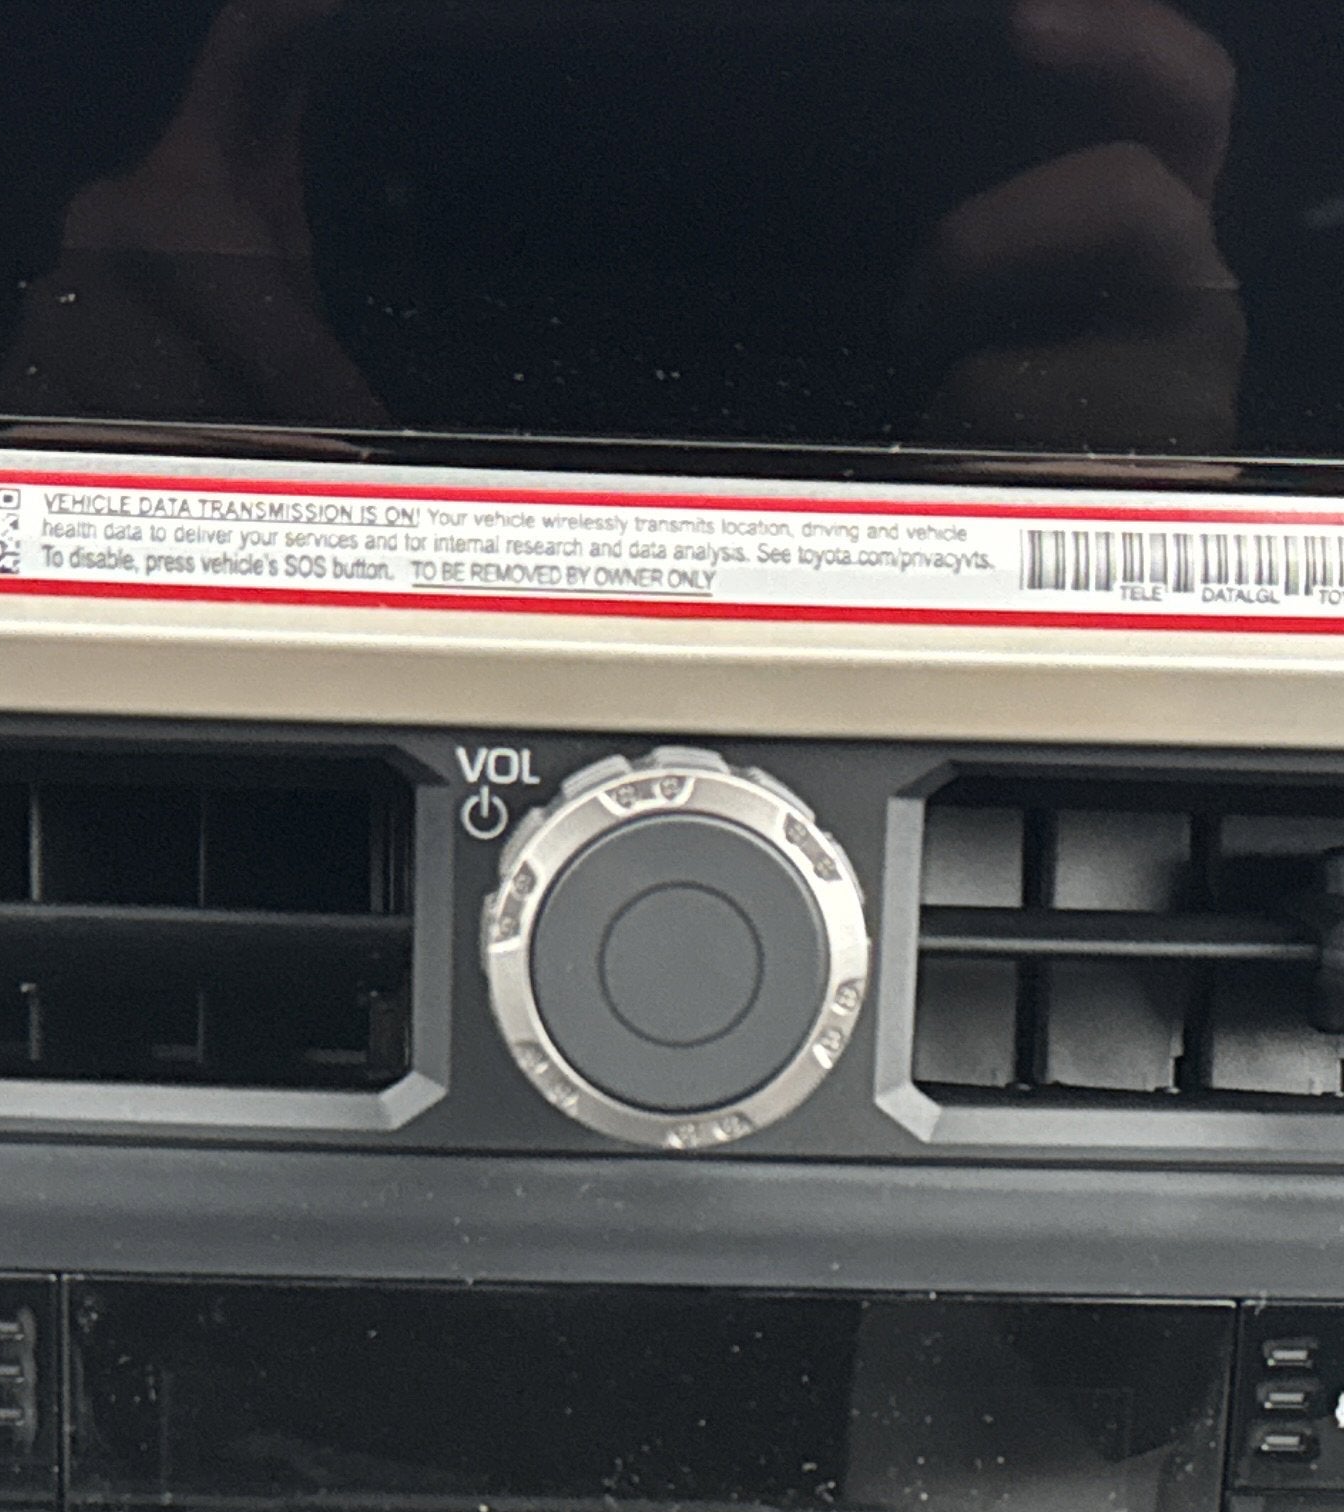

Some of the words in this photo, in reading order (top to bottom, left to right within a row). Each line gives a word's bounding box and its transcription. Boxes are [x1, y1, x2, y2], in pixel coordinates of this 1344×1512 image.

[44, 492, 132, 515] VEHICLE
[139, 496, 191, 517] DATA
[198, 499, 353, 523] TRANSMISSION
[361, 505, 377, 523] IS
[385, 506, 420, 525] ON!
[428, 508, 468, 526] Your
[474, 510, 535, 528] vehicle
[542, 513, 627, 535] wirelessly
[635, 516, 715, 534] transmits
[722, 519, 794, 538] location,
[802, 521, 859, 543] driving
[867, 524, 899, 540] and
[906, 524, 968, 542] vehicle
[42, 518, 97, 539] health
[104, 521, 142, 541] data
[150, 525, 166, 542] to
[174, 525, 232, 544] deliver
[240, 530, 278, 550] your
[285, 532, 358, 549] services
[365, 532, 397, 550] and
[405, 534, 426, 552] for
[433, 535, 499, 554] internal
[506, 538, 584, 556] research
[589, 540, 622, 558] and
[628, 541, 667, 559] data
[673, 542, 750, 567] analysis.
[757, 543, 791, 564] See
[42, 544, 64, 568] To
[70, 546, 139, 574] disable,
[146, 553, 196, 575] press
[201, 552, 278, 577] vehicle's
[285, 554, 327, 579] SOS
[332, 556, 395, 581] button.
[412, 560, 437, 581] TO
[442, 562, 465, 581] BE
[470, 562, 562, 585] REMOVED
[566, 565, 591, 585] BY
[594, 566, 663, 588] OWNER
[667, 569, 716, 590] ONLY
[1120, 585, 1163, 603] TELE
[456, 747, 540, 785] VOL
